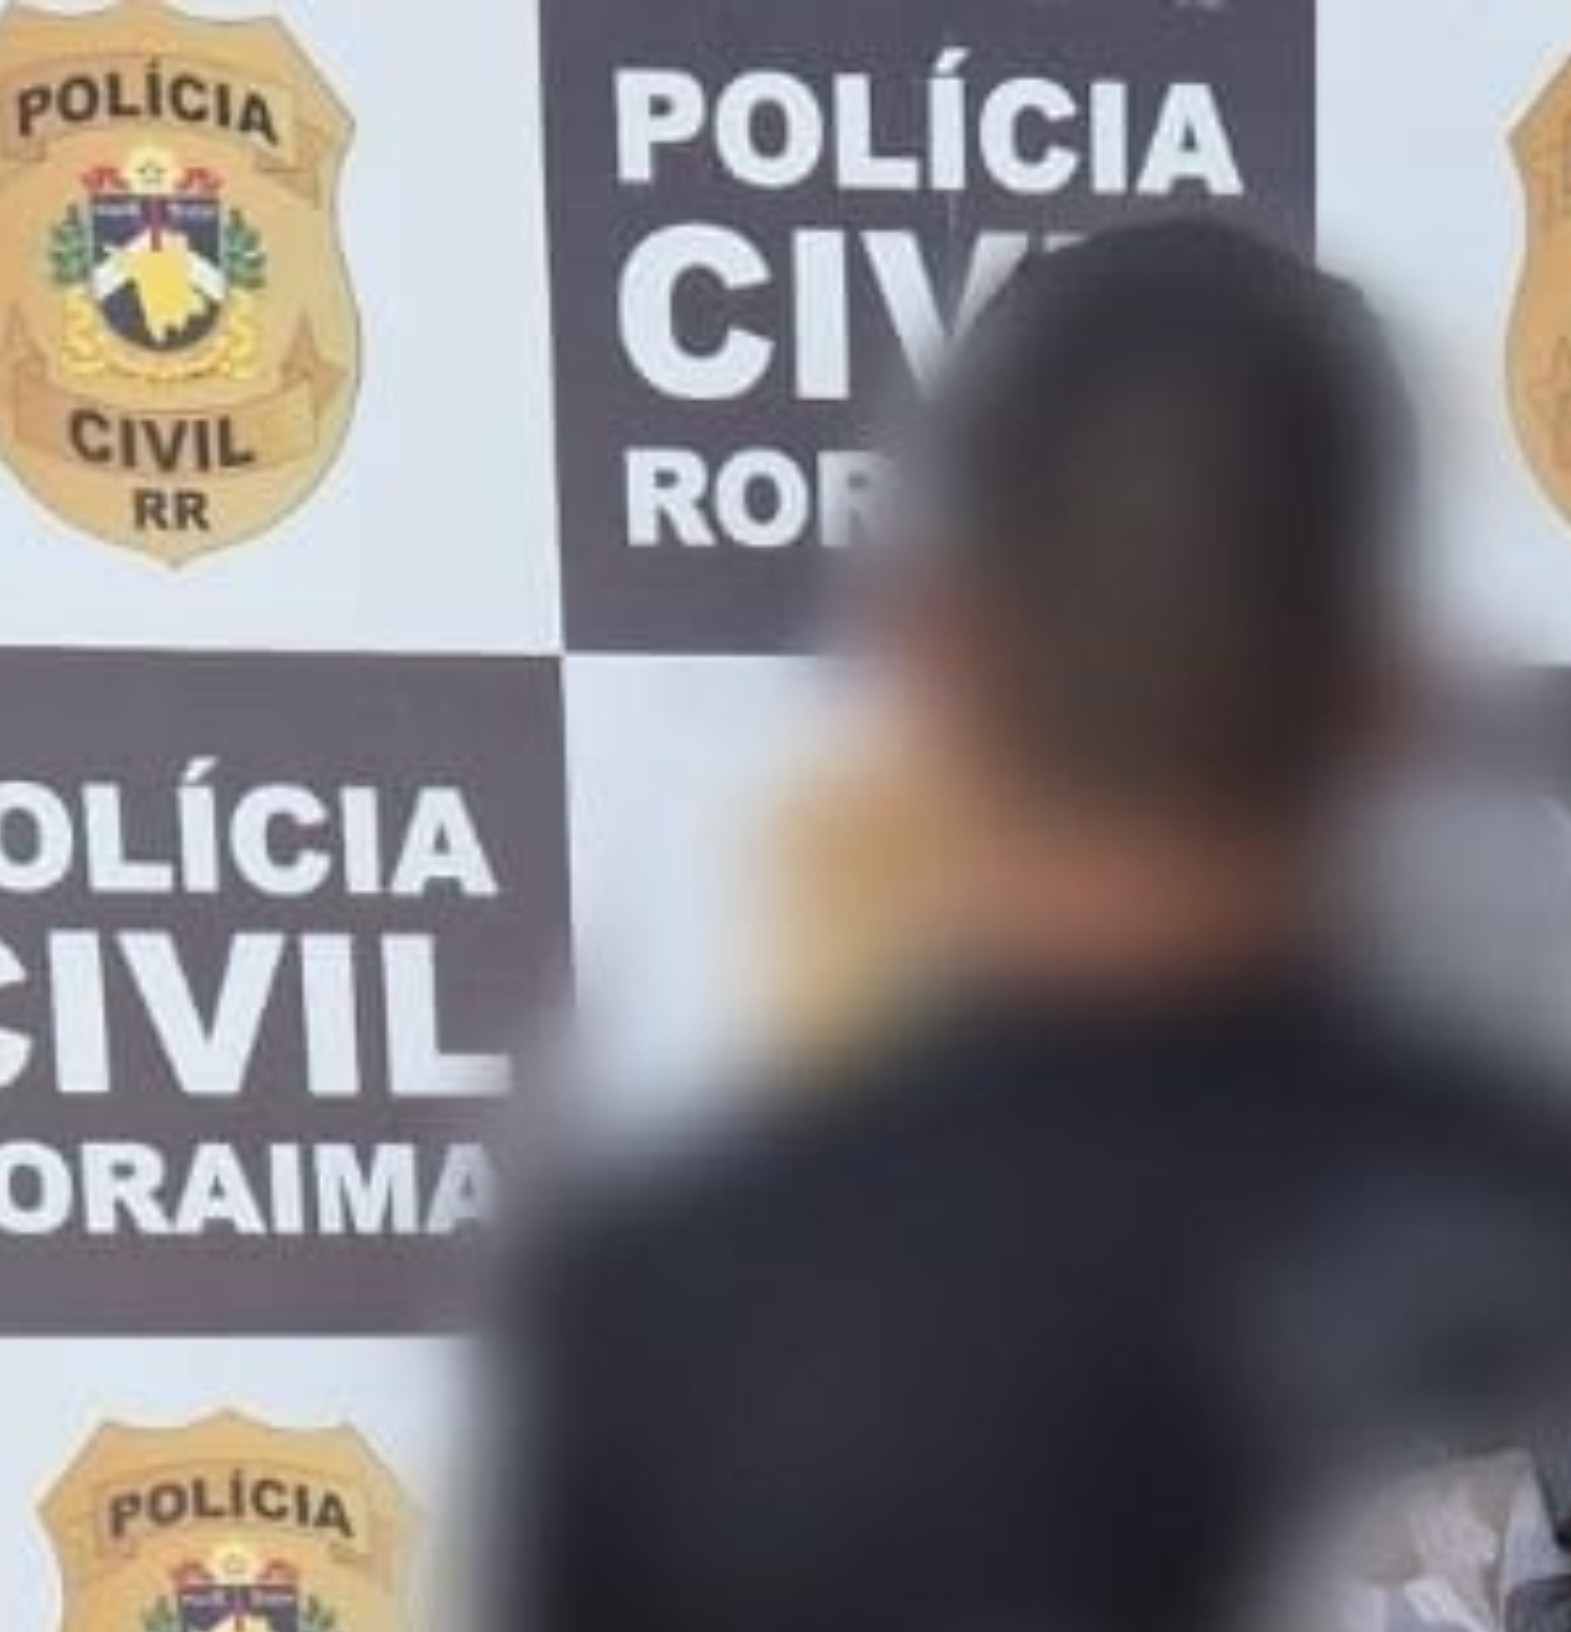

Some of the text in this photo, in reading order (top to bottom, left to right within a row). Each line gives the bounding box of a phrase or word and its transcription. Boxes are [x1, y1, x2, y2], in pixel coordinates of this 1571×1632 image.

[16, 63, 279, 146] POLÍCIA
[613, 47, 1244, 196] POLÍCIA
[69, 411, 257, 472] CIVIL
[133, 489, 210, 531] RR
[0, 931, 512, 1096] IVIL
[107, 1469, 353, 1539] POLÍCIA
